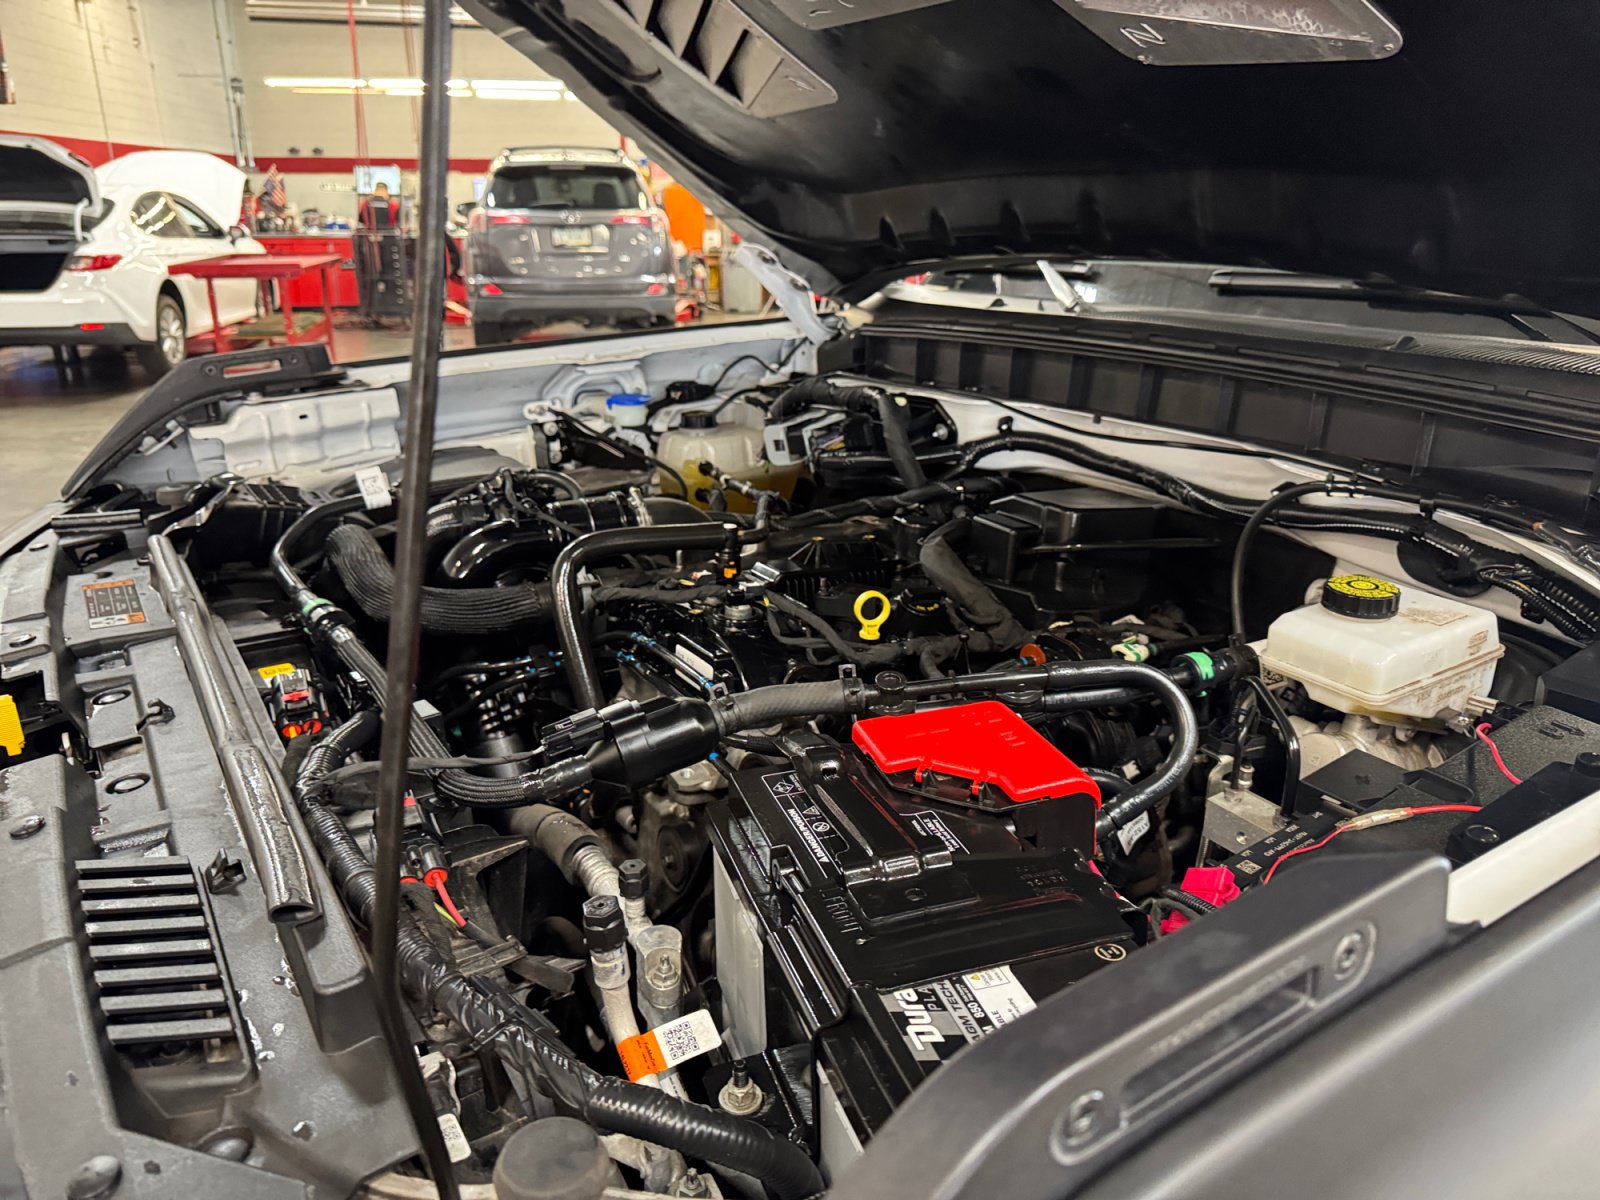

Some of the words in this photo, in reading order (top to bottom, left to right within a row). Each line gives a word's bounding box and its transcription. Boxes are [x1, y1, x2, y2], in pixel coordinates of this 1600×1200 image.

[823, 893, 862, 932] FRONT
[893, 988, 946, 1051] Dura
[966, 1002, 985, 1018] 850
